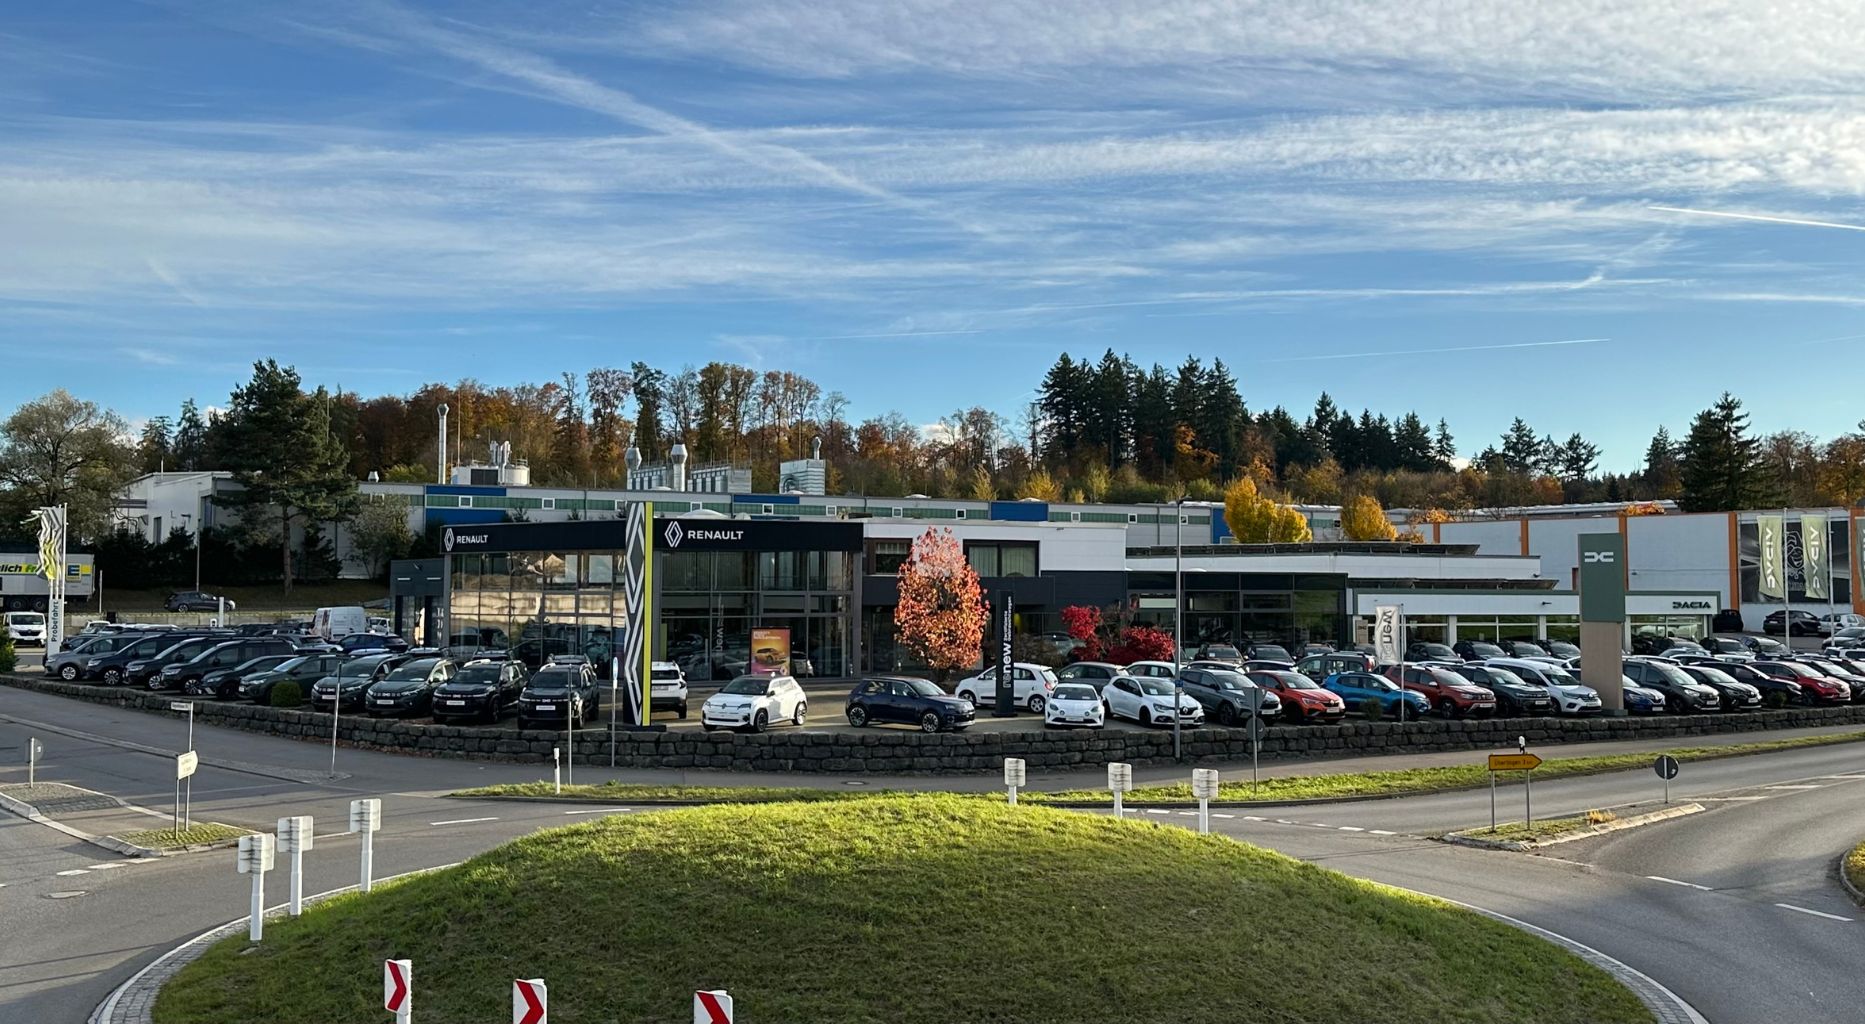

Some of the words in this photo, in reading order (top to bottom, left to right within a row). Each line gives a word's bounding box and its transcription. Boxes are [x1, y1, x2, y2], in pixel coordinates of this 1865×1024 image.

[456, 534, 488, 544] RENAULT
[687, 530, 744, 540] RENAULT
[1672, 601, 1711, 609] DACIA
